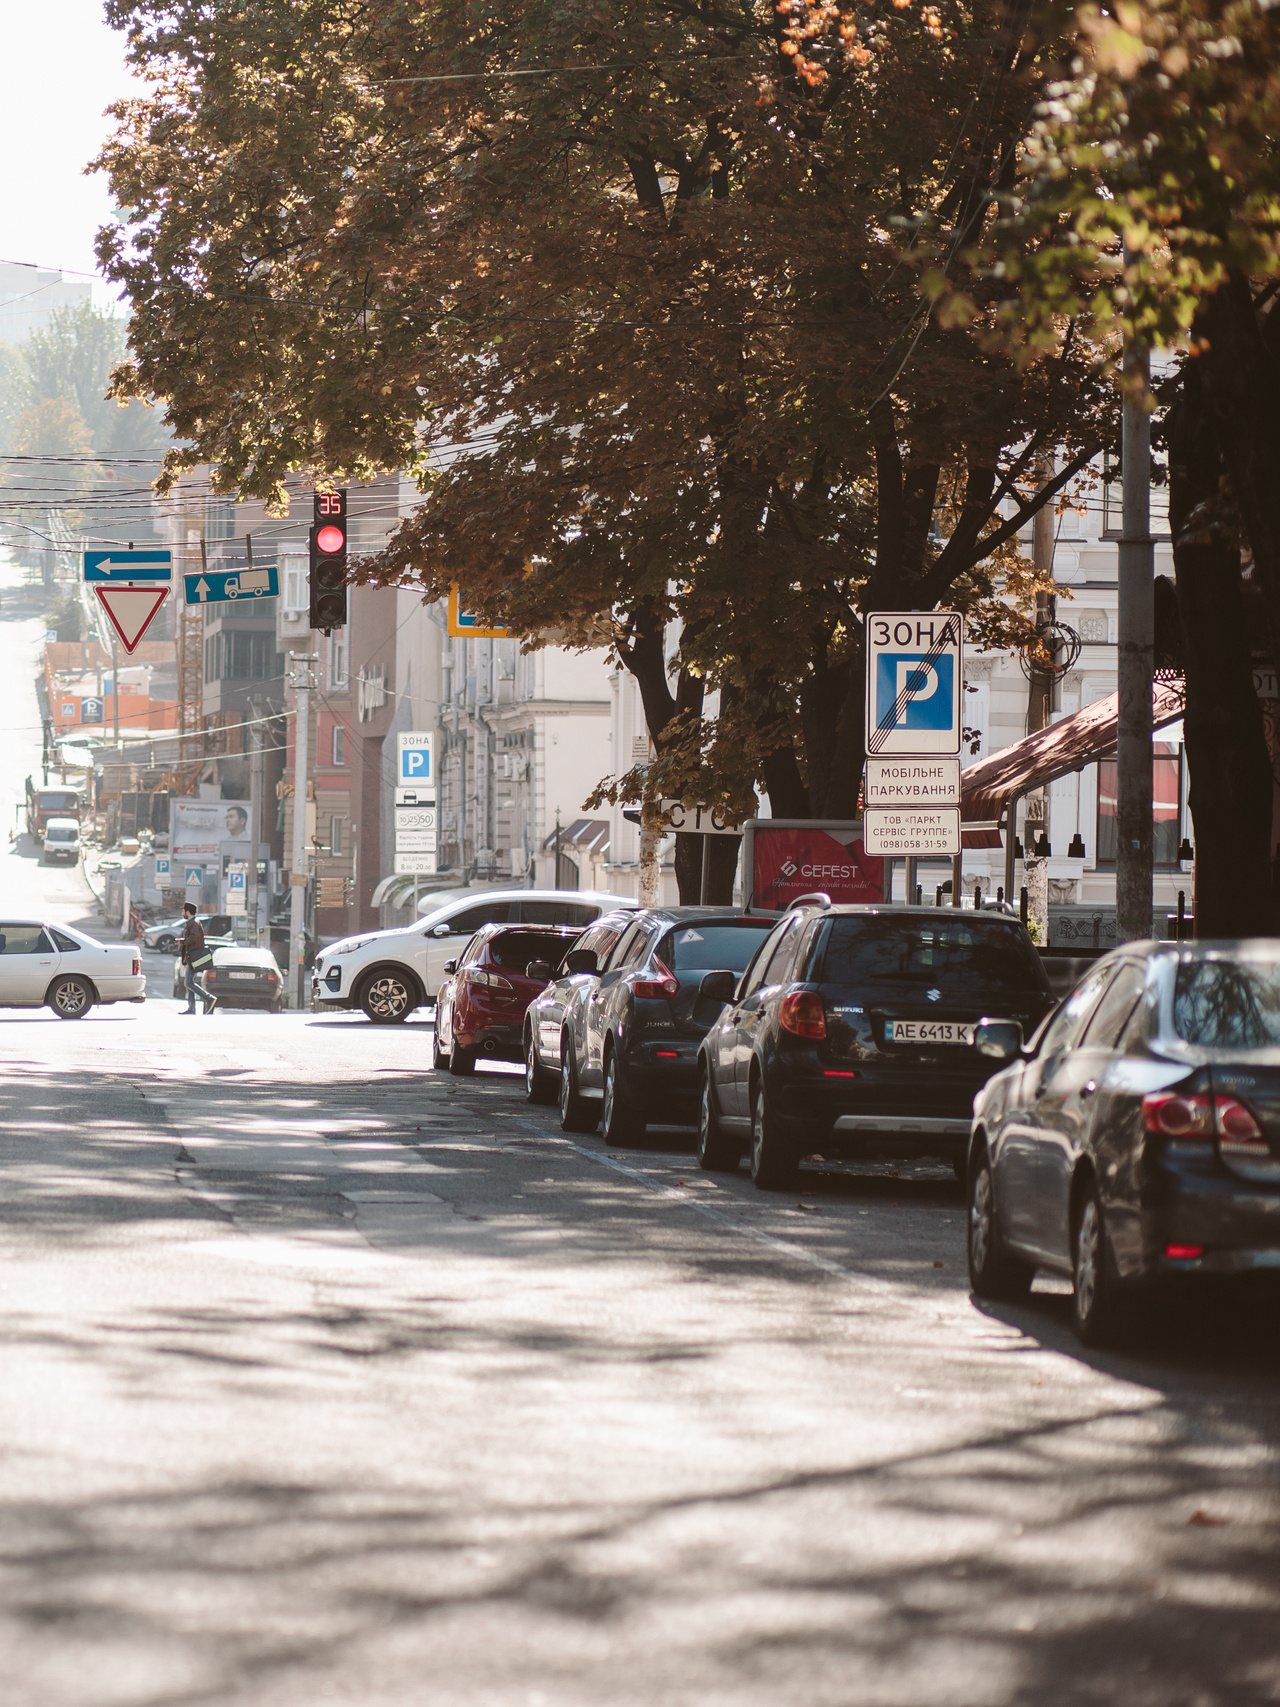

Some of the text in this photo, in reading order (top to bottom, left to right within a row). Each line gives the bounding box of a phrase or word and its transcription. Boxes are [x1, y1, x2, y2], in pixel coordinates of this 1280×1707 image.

[320, 496, 341, 515] 35
[873, 621, 958, 646] ЗОНА
[402, 736, 430, 745] ЗОНА
[881, 767, 944, 778] МОБІЛЬНЕ
[870, 785, 956, 795] ПАРКУВАННЯ
[420, 815, 431, 824] 50
[883, 815, 942, 824] ТОВ «ПАРКТ
[872, 828, 952, 836] СЕРВІС ГРУППЕ»
[880, 840, 947, 848] (098)058-31-59
[800, 864, 859, 878] GEFEST
[833, 1006, 863, 1014] SUZUKI
[895, 1024, 970, 1040] AE 6413 K
